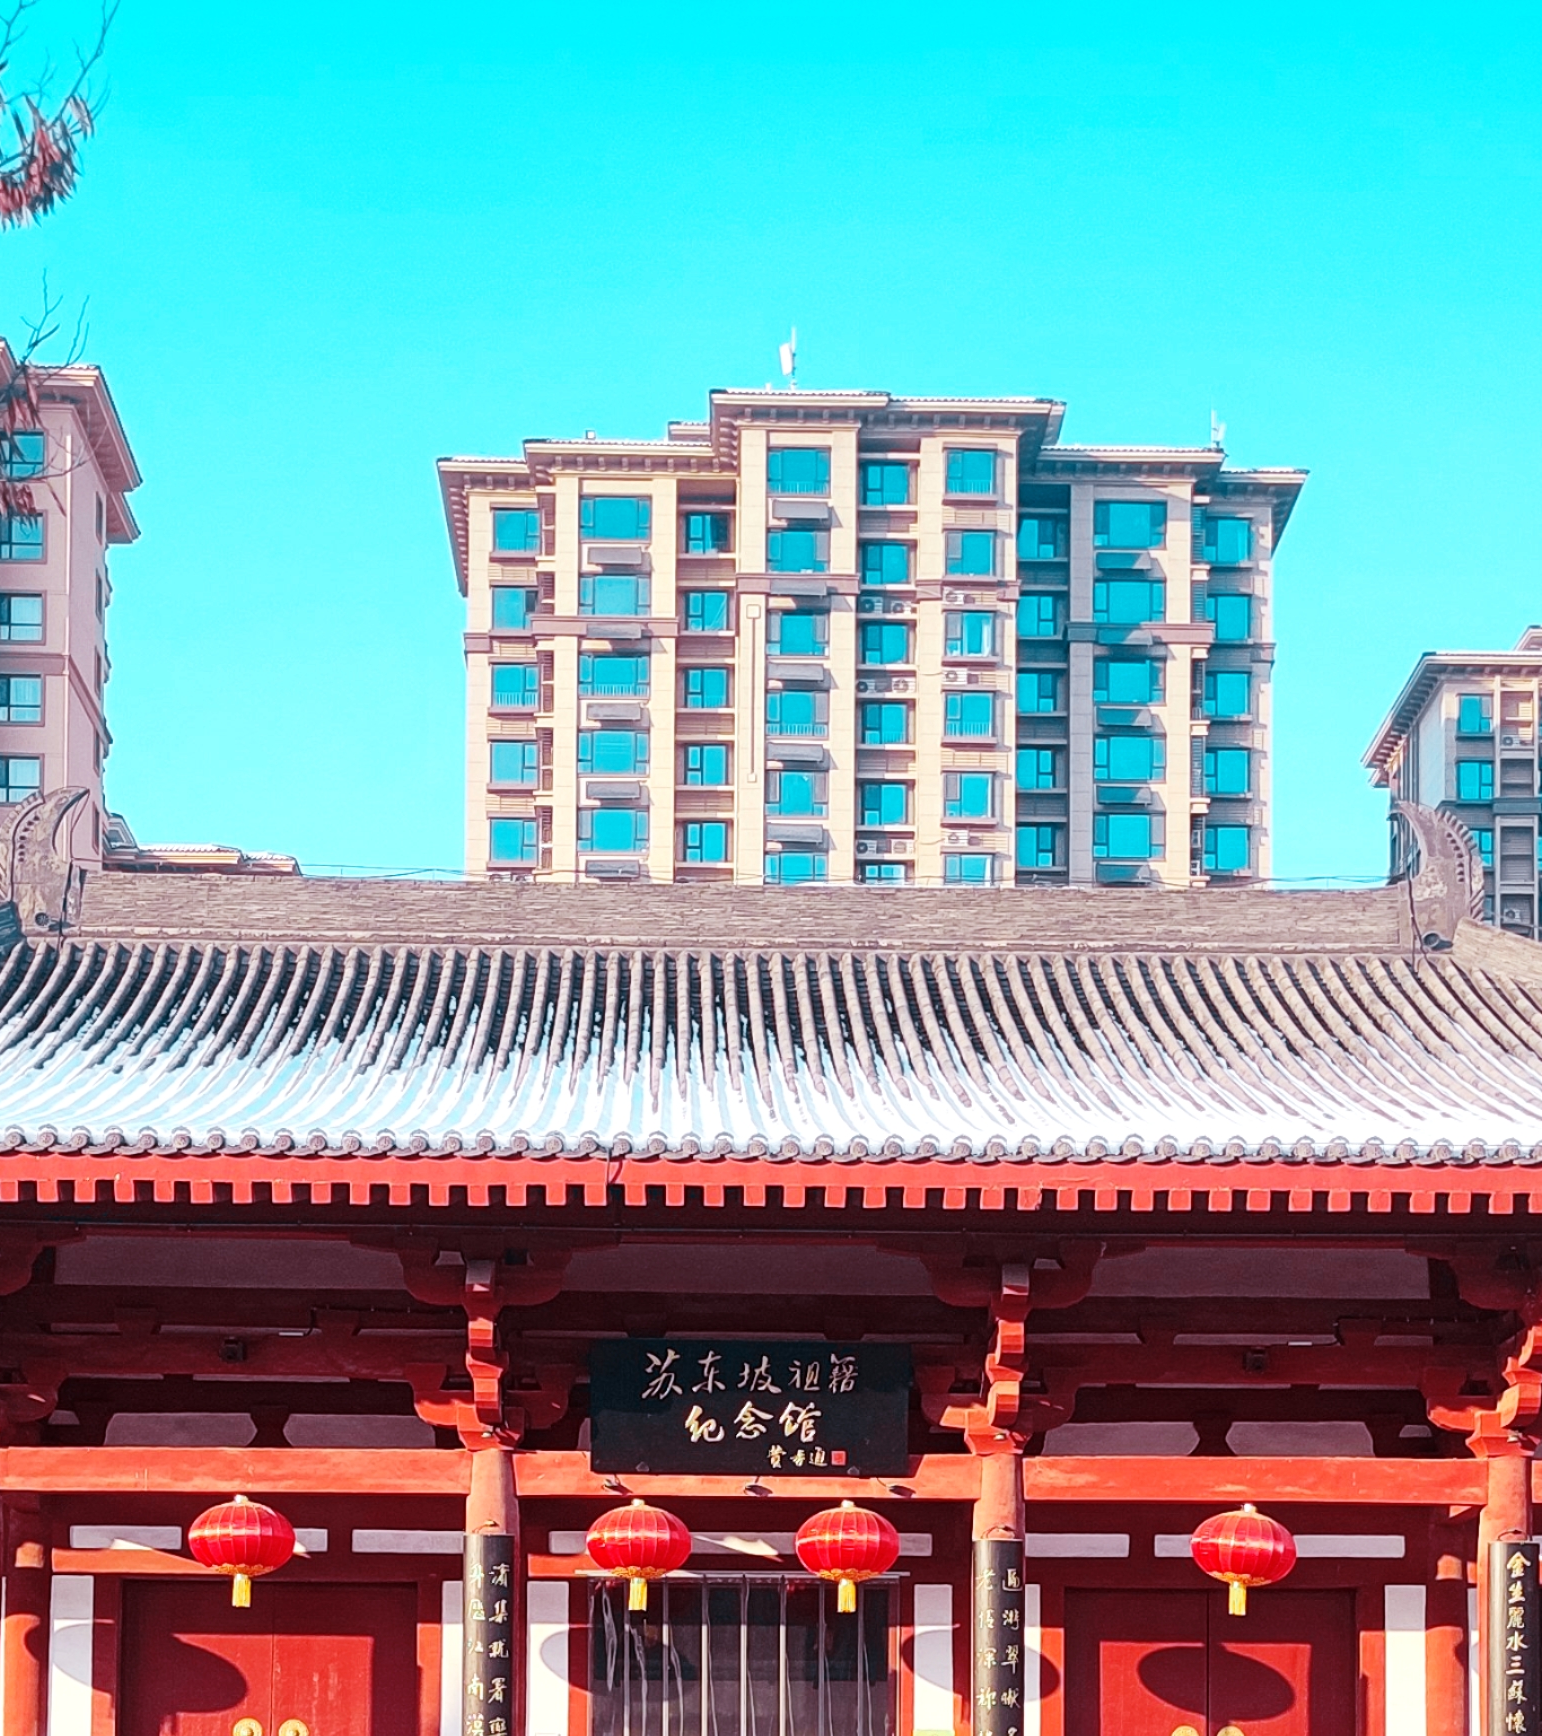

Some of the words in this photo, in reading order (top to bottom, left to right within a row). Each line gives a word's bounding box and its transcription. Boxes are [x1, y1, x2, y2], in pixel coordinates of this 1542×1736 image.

[641, 1347, 860, 1401] 苏东坡祖籍
[684, 1400, 824, 1443] 纪念馆
